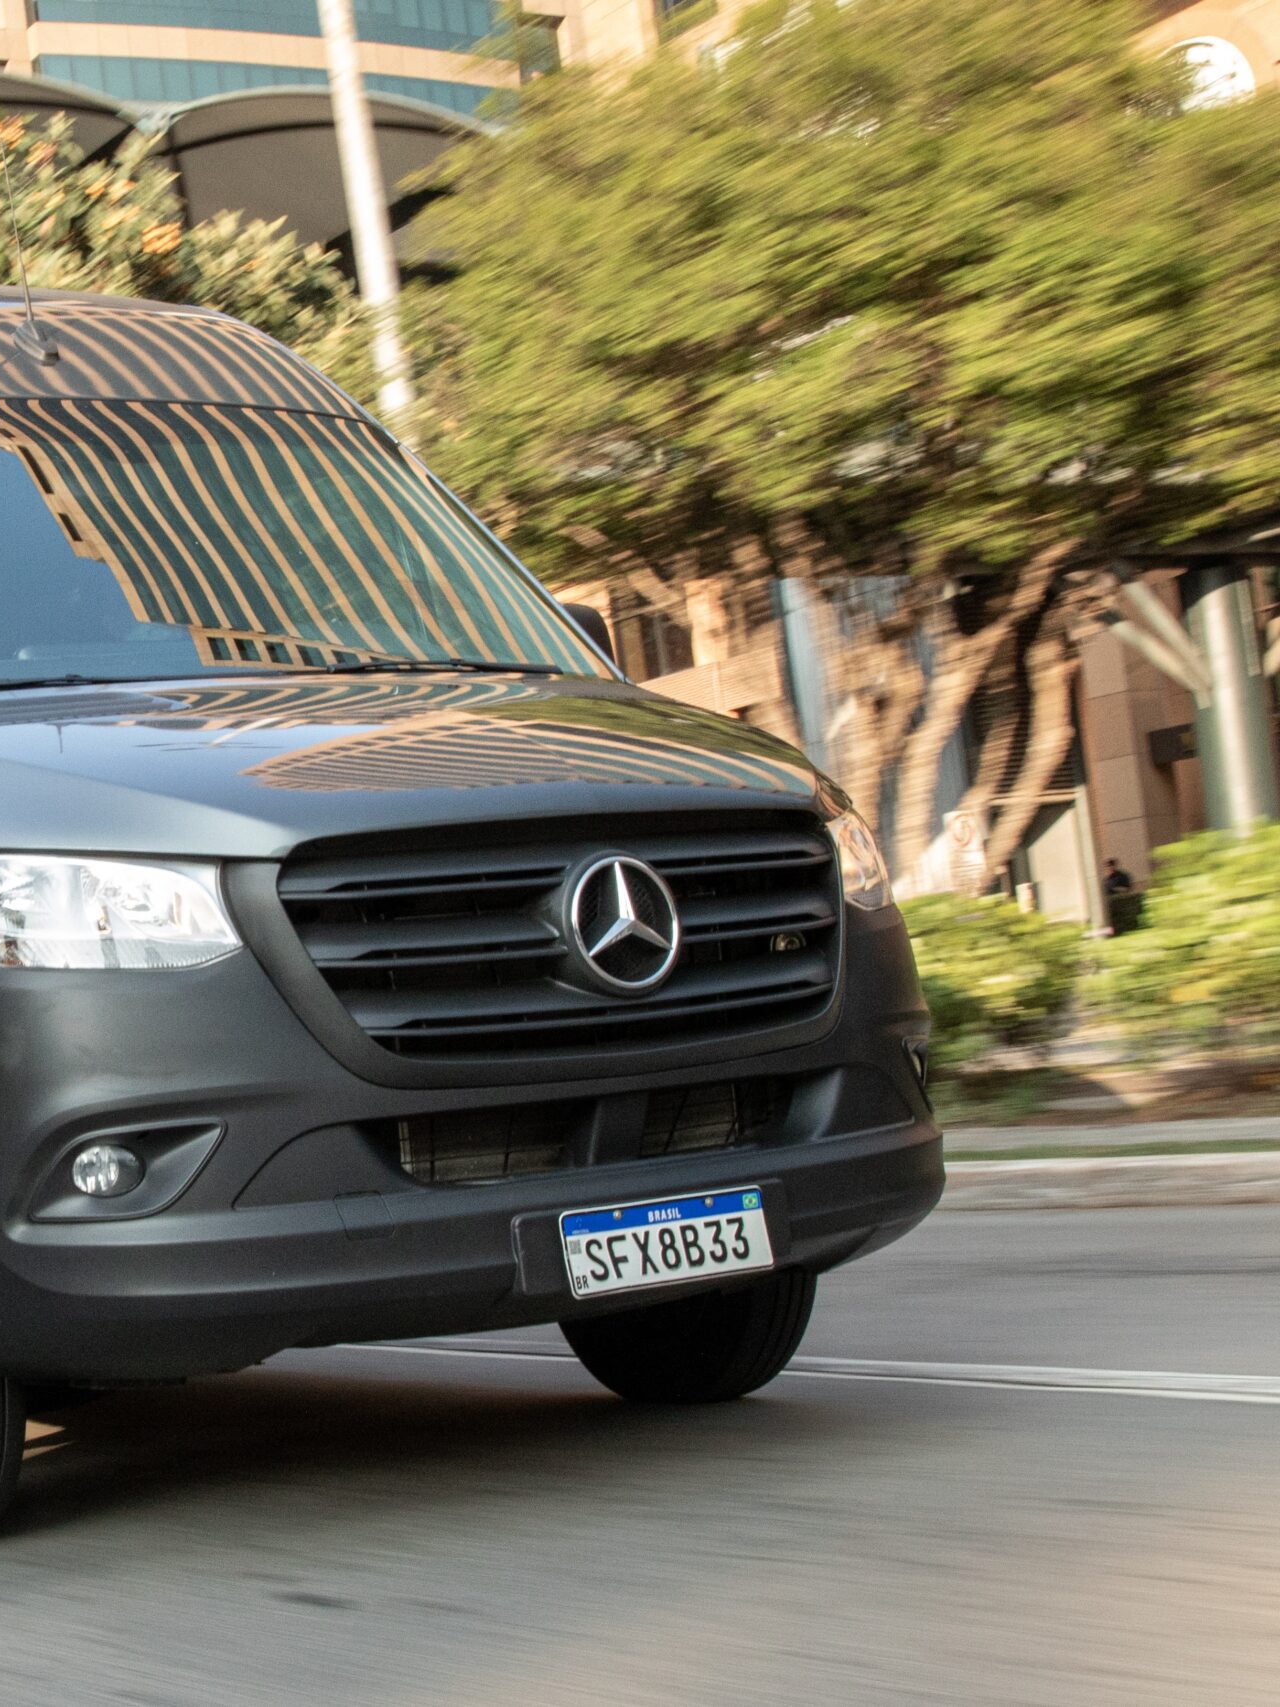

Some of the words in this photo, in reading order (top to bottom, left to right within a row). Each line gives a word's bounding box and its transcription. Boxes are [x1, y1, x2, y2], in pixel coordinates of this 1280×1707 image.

[647, 1207, 682, 1222] BRASIL
[585, 1216, 750, 1282] SFX8B33
[575, 1275, 589, 1290] BR
